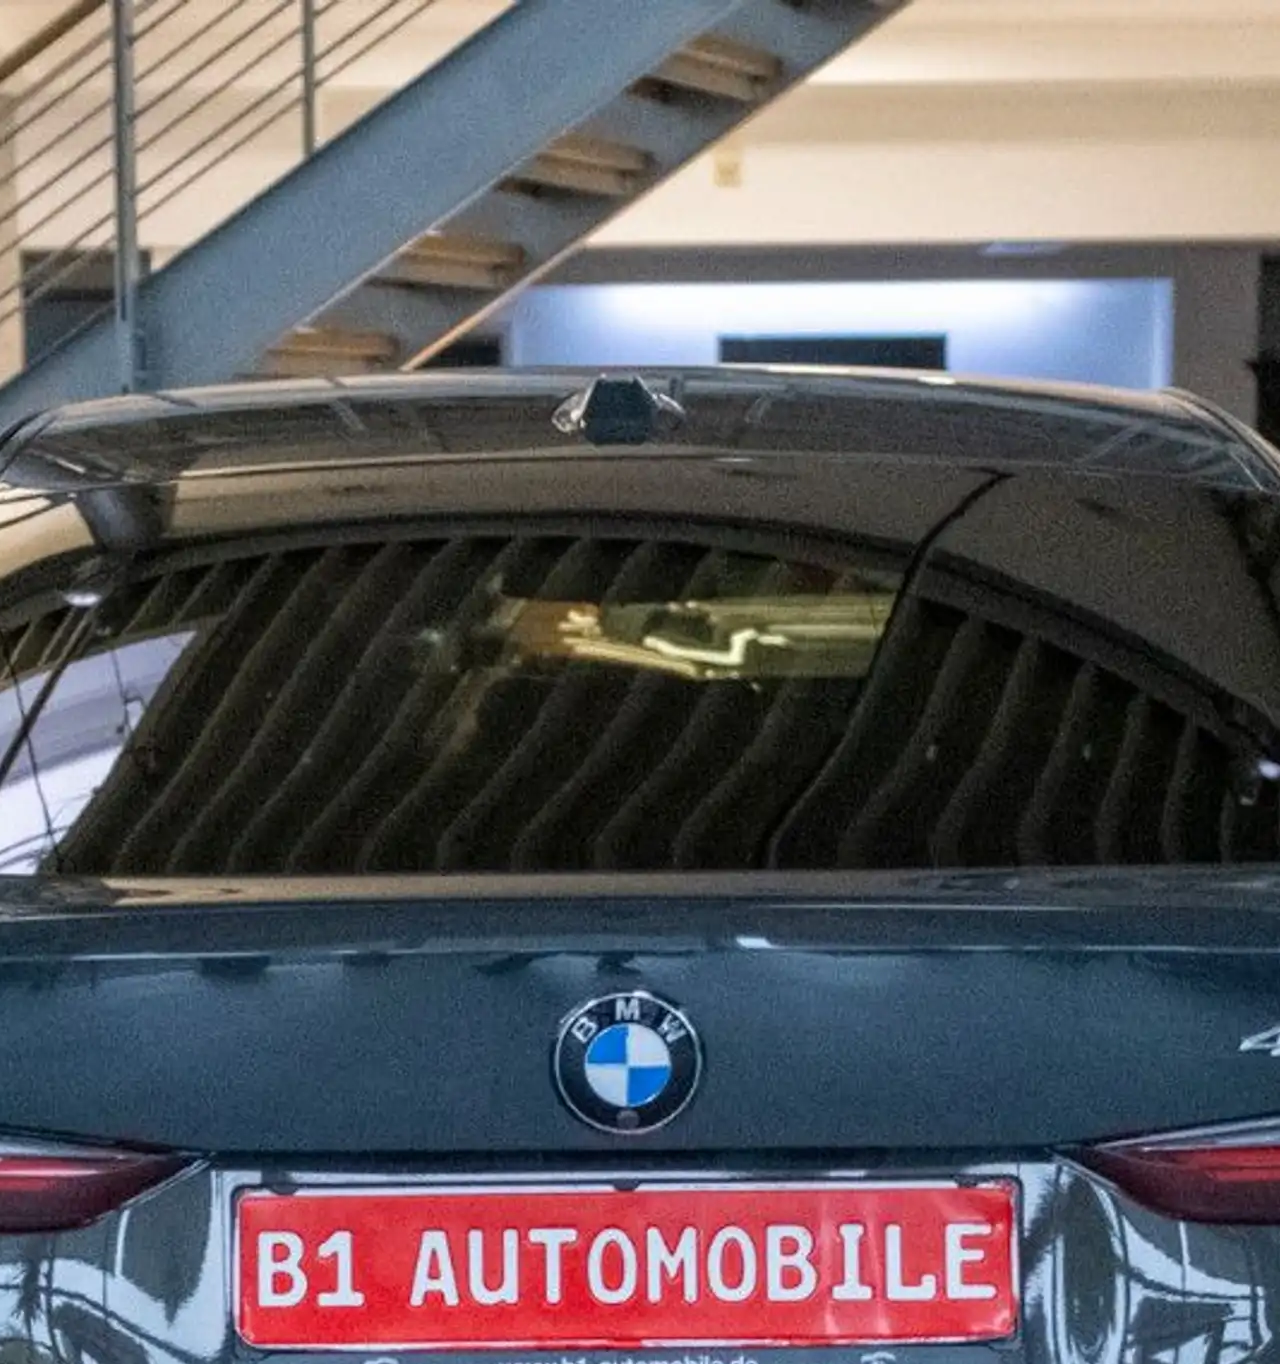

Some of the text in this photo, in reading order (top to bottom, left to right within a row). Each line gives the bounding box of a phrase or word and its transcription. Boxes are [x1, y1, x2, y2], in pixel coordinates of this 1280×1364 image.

[571, 998, 687, 1044] BMW
[256, 1223, 998, 1308] B1 AUTOMOBILE
